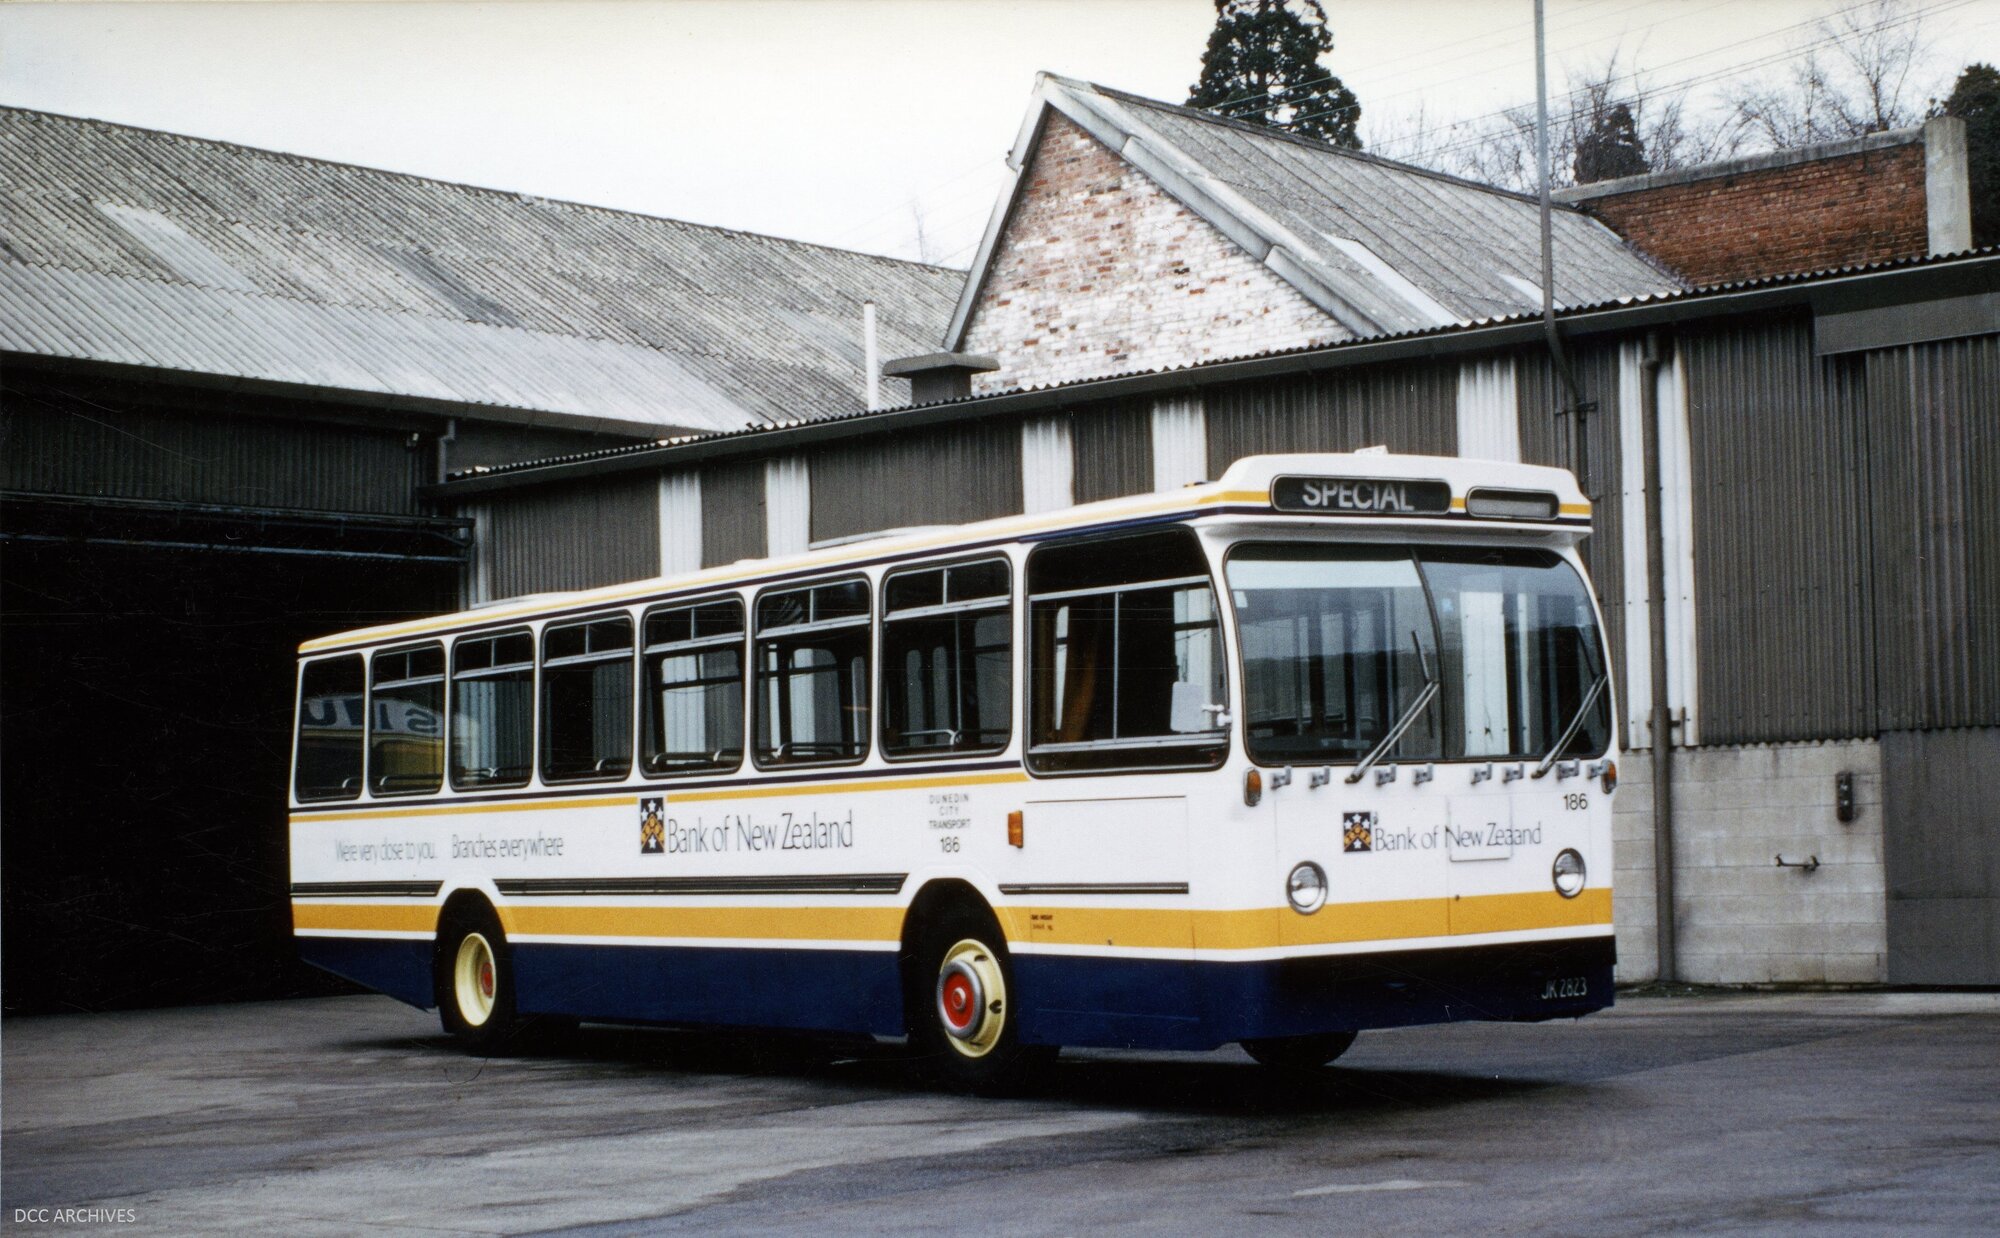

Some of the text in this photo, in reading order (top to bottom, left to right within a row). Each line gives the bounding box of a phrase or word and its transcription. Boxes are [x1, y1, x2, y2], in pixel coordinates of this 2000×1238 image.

[1302, 481, 1415, 511] SPECIAL
[929, 793, 969, 804] DUNEDIN
[1563, 793, 1588, 811] 186
[940, 805, 959, 816] CITY
[668, 809, 853, 853] Bank of New Zealand
[928, 818, 971, 829] TRANSPORT
[381, 836, 403, 860] close
[405, 841, 416, 860] to
[452, 833, 497, 858] Branches
[500, 830, 563, 861] everywhere
[940, 836, 960, 853] 186
[1375, 826, 1417, 851] Bank
[1421, 825, 1440, 849] of
[1445, 825, 1482, 848] New
[1541, 976, 1587, 999] JK 2823
